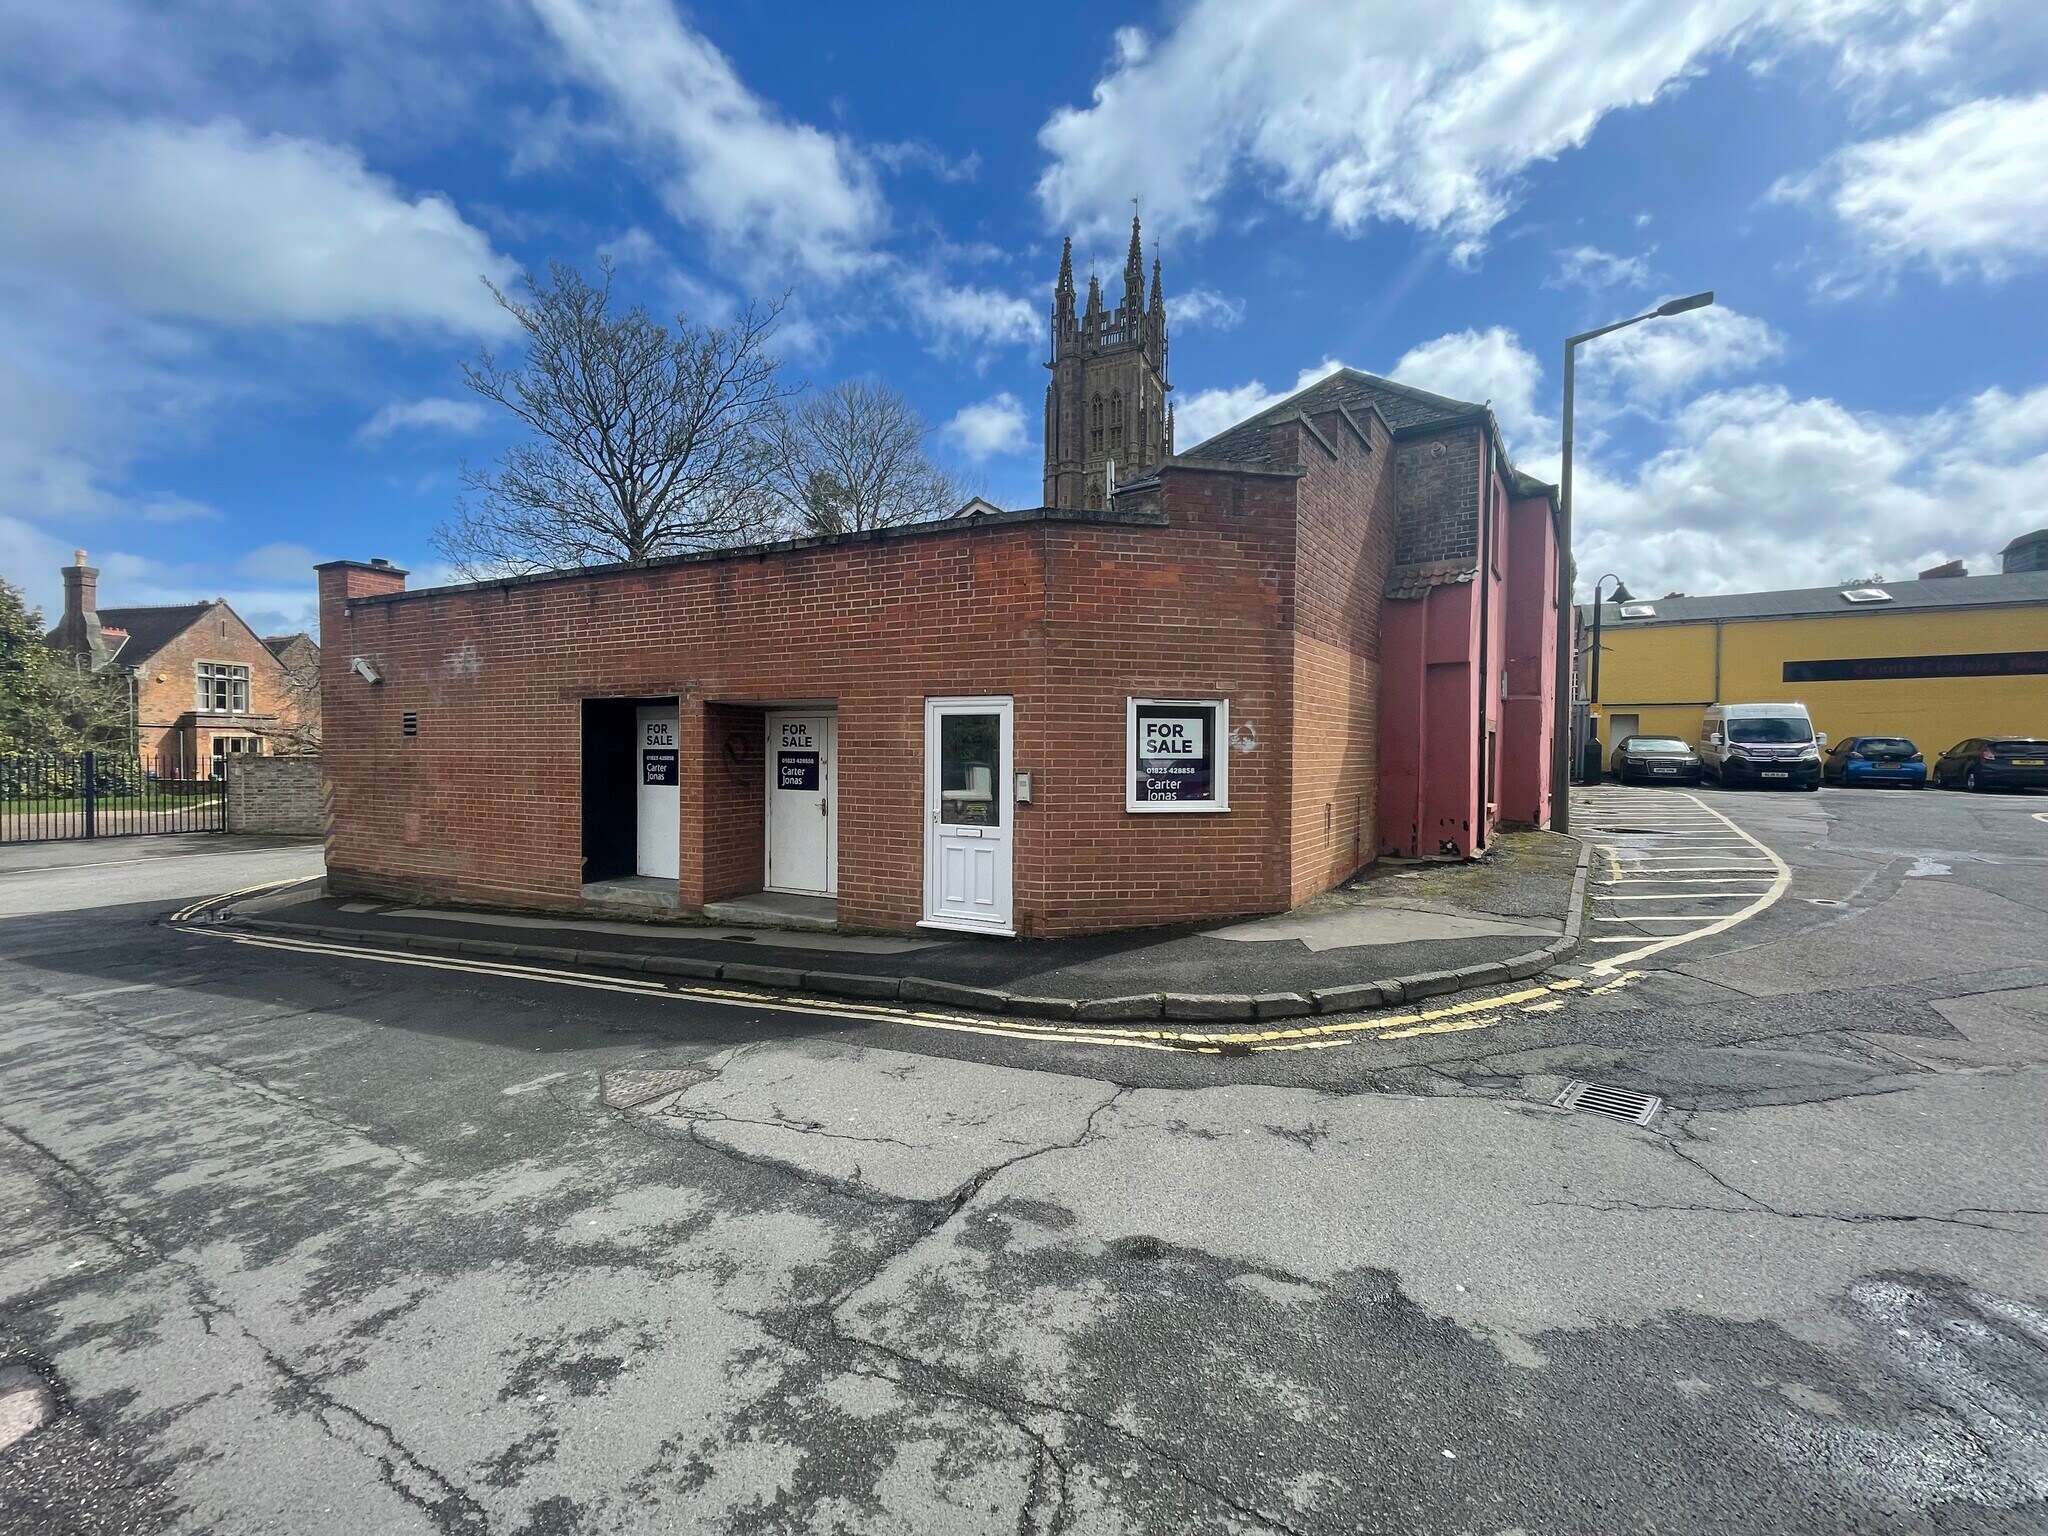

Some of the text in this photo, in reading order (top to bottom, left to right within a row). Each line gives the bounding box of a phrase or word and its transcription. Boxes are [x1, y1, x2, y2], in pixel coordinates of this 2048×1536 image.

[647, 724, 667, 734] FOR
[783, 724, 806, 735] FOR
[1147, 724, 1184, 737] FOR
[647, 736, 672, 745] SALE
[782, 736, 812, 747] SALE
[1146, 739, 1193, 753] SALE
[647, 763, 667, 772] Carter
[782, 766, 805, 775] Carter
[647, 772, 664, 781] Jonas
[782, 776, 802, 786] Jonas
[1147, 778, 1181, 789] Carter
[1148, 790, 1177, 801] Jonas
